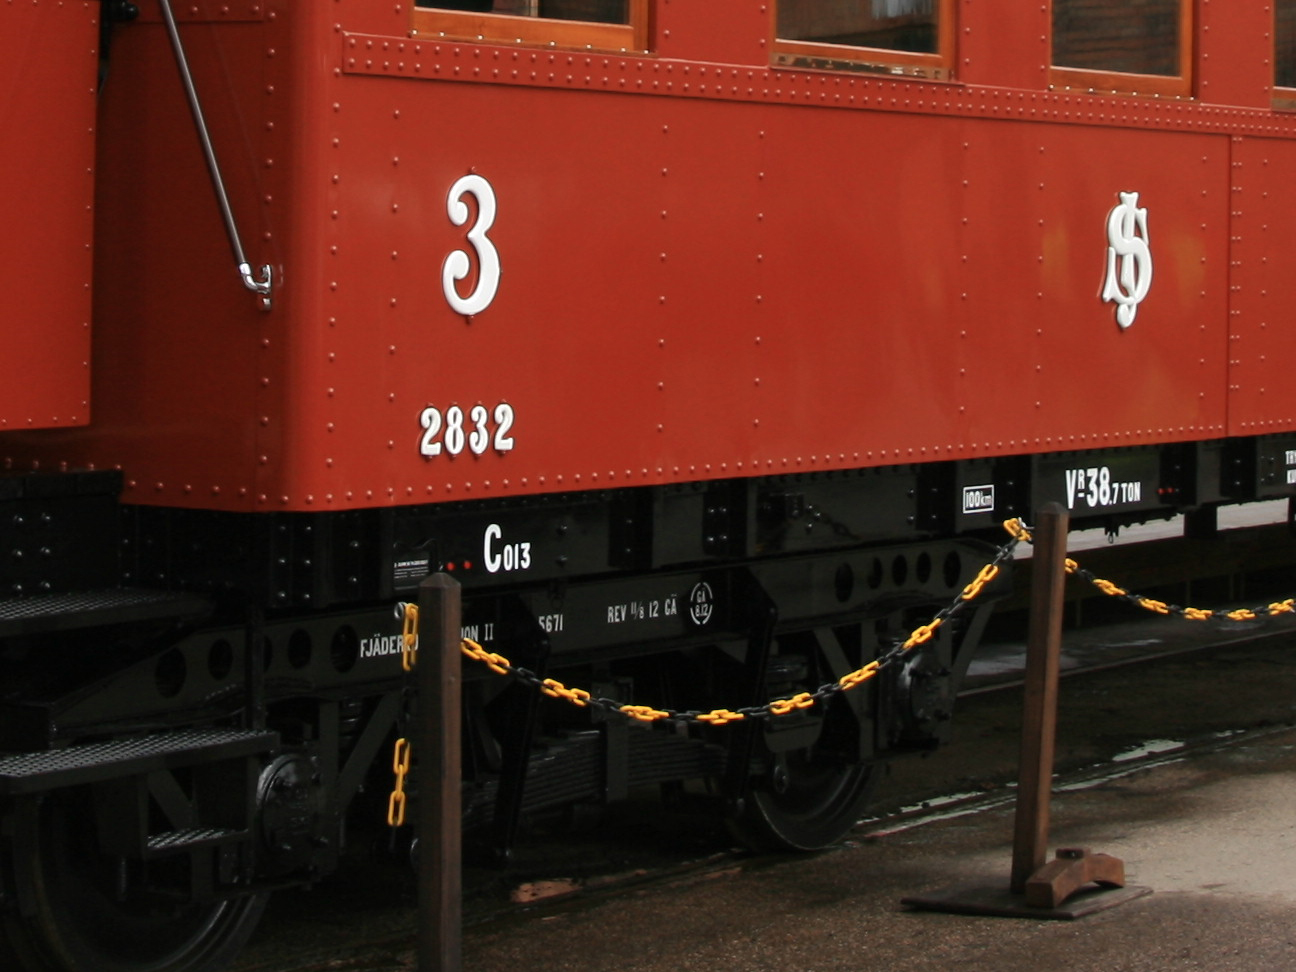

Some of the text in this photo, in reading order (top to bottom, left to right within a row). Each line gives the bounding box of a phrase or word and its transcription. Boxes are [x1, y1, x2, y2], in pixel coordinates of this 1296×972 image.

[442, 174, 501, 316] 3
[420, 403, 515, 456] 2832
[1122, 481, 1142, 504] TON
[538, 613, 564, 633] 5671
[607, 605, 627, 624] REV
[649, 600, 659, 618] 12
